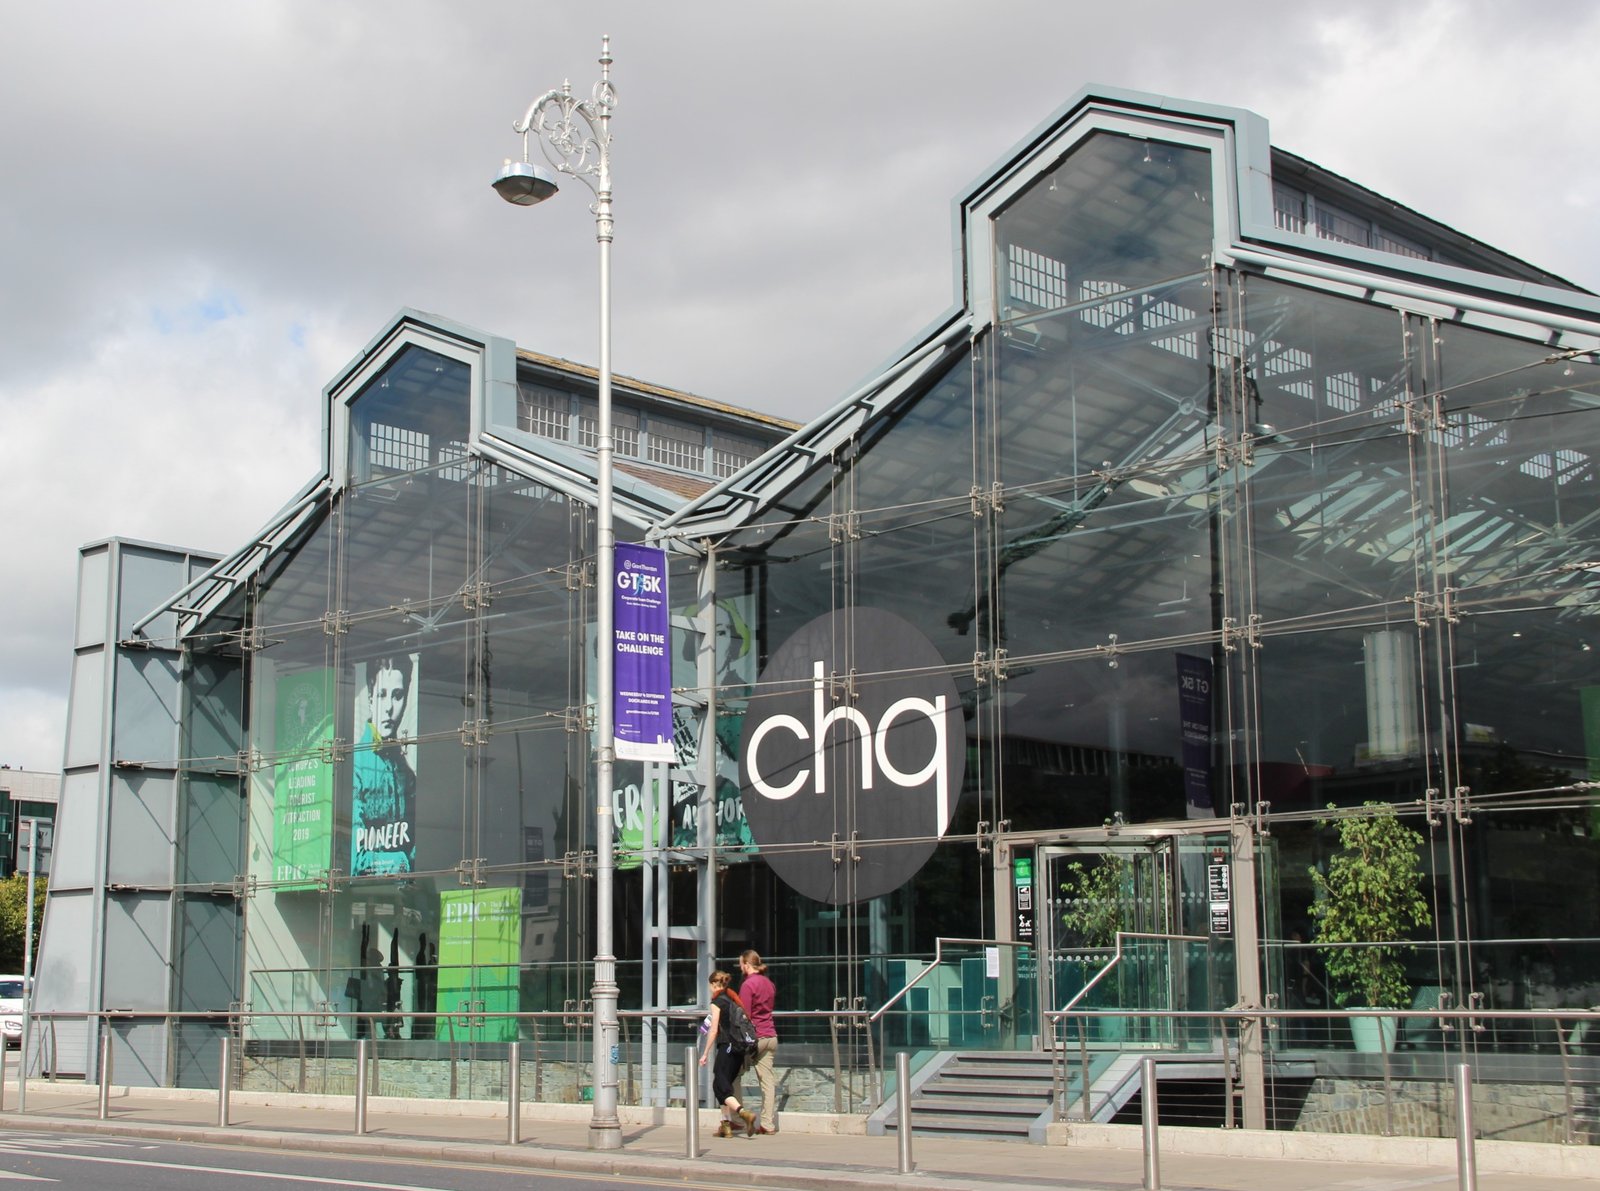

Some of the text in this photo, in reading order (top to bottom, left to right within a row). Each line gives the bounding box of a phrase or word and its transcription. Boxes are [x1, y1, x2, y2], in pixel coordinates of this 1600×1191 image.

[615, 630, 665, 644] TAKE ON THE
[616, 642, 664, 656] CHALLENGE
[747, 660, 949, 841] chq
[292, 828, 310, 841] 2019
[356, 821, 411, 853] PIONEER
[277, 864, 306, 881] EPIC
[446, 902, 487, 924] EPIC
